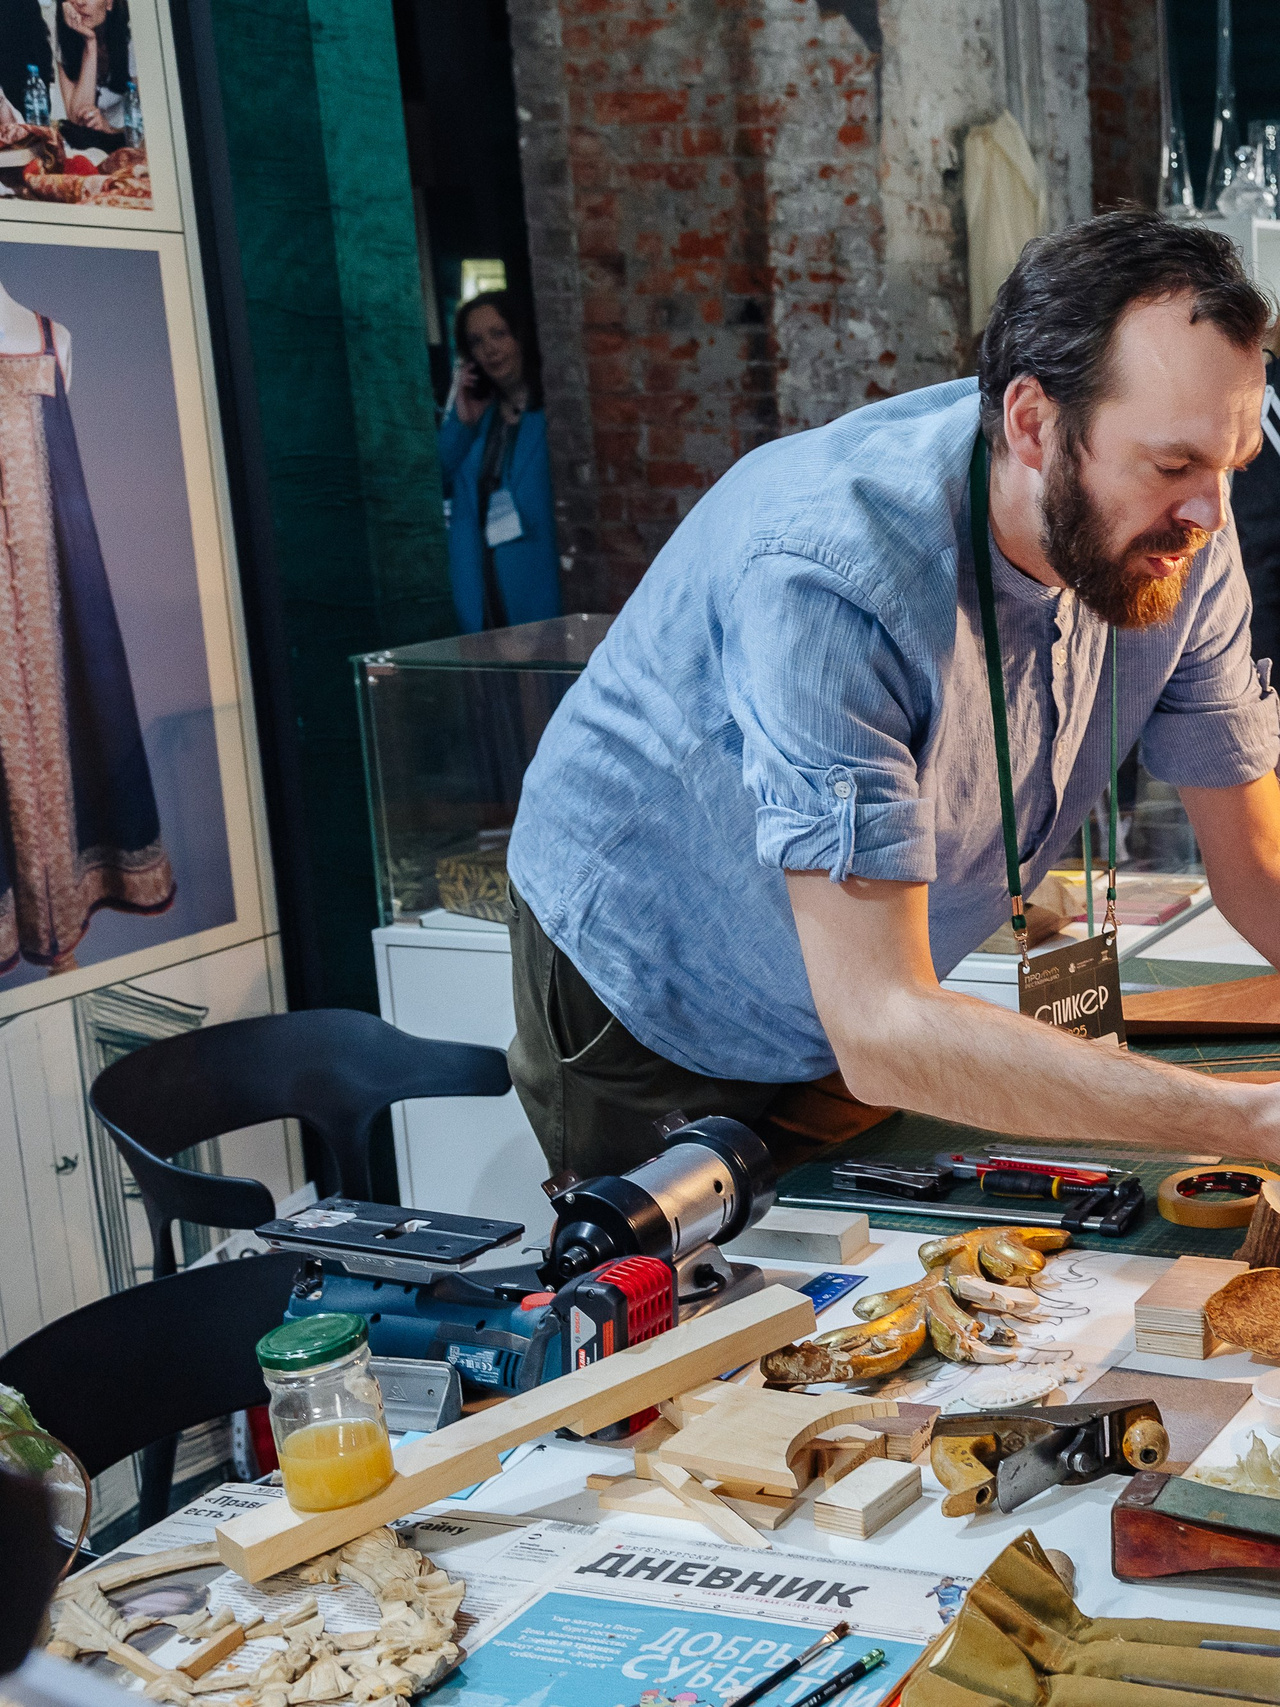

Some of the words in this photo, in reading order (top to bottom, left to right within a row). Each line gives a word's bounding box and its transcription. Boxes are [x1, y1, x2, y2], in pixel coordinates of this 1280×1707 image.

[183, 1507, 224, 1518] есть
[412, 1520, 471, 1536] тайну
[622, 1544, 720, 1562] ПЕТЕРБУРГСКИЙ
[574, 1552, 869, 1608] ДНЕВНИК
